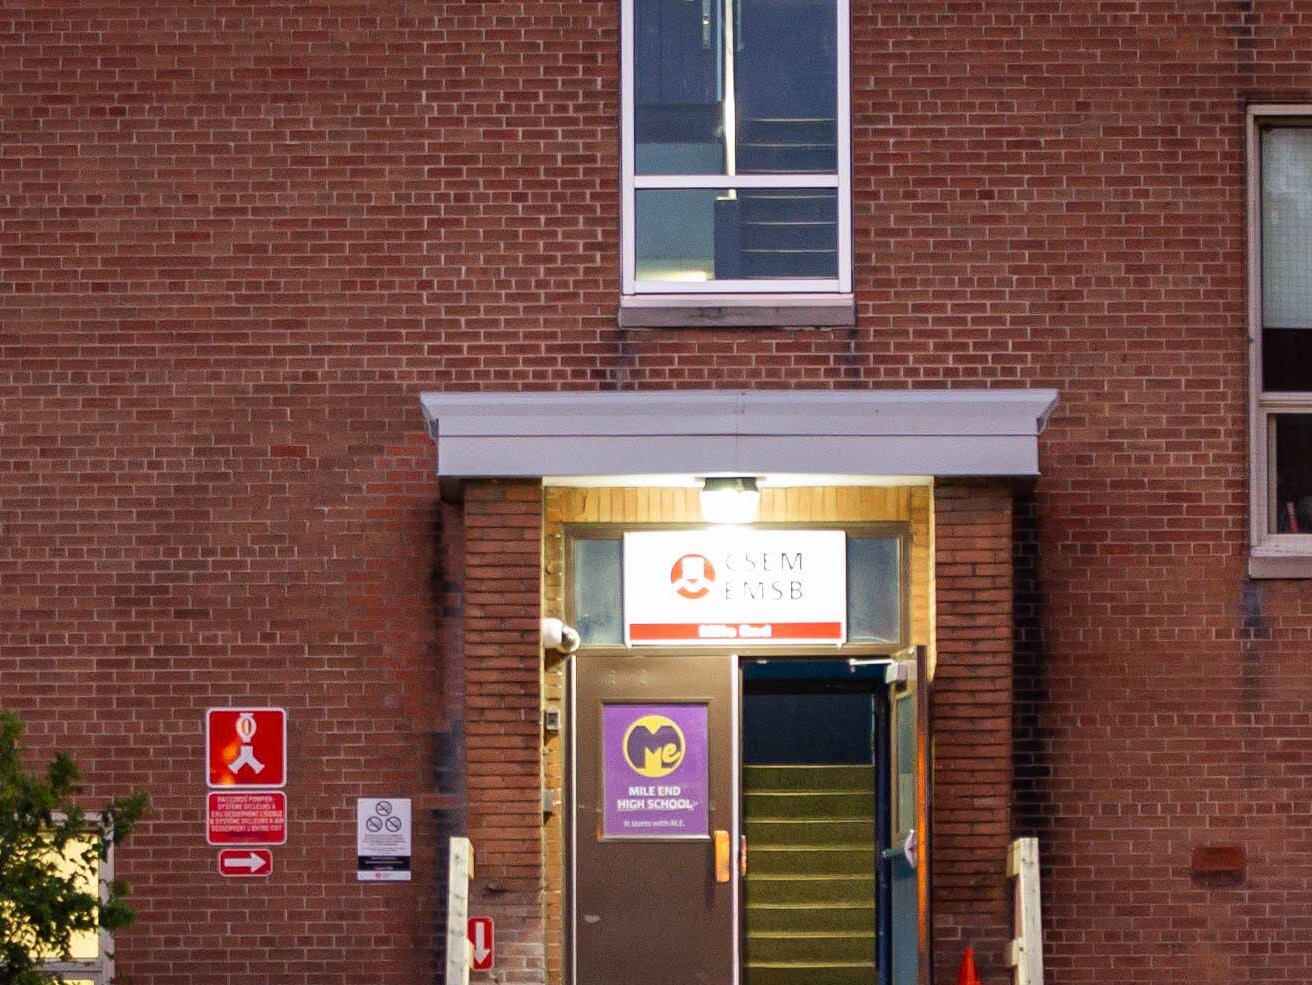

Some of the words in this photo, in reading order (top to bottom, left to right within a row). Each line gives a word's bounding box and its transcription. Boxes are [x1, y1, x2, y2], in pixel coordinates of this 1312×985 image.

[725, 552, 803, 571] CSEM
[725, 581, 803, 600] EMSB
[629, 786, 656, 797] MILE
[657, 786, 681, 797] END
[617, 799, 646, 809] HIGH
[647, 799, 694, 810] SCHOOL
